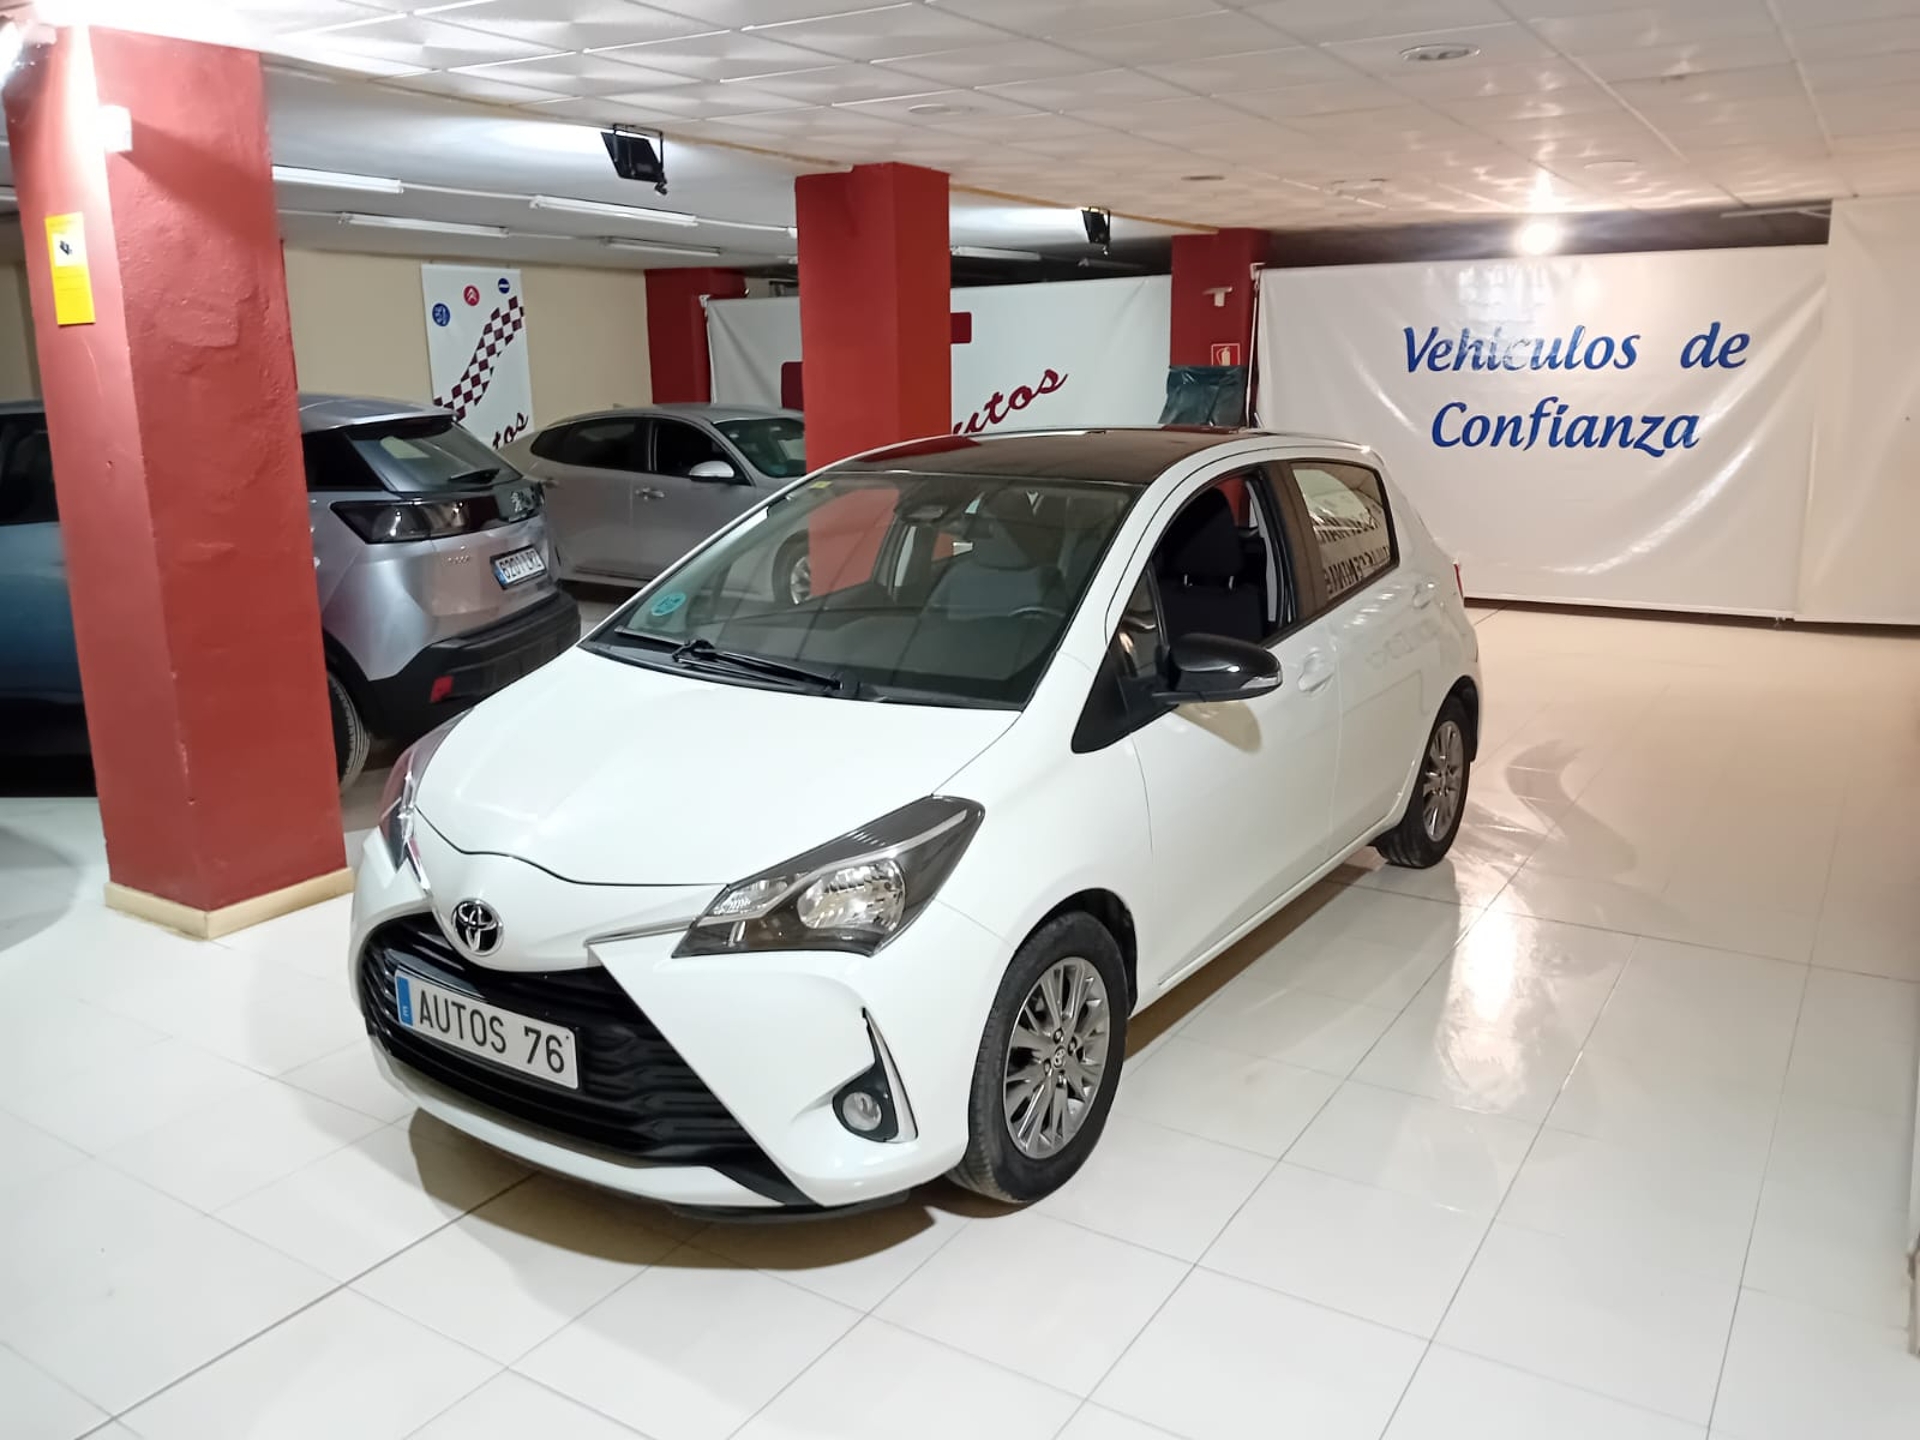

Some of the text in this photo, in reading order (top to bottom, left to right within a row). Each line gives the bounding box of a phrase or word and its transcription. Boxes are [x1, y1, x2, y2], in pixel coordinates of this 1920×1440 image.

[1680, 321, 1751, 369] de
[492, 412, 529, 450] tos
[953, 368, 1068, 434] utos
[1432, 396, 1700, 458] Confianza
[419, 989, 565, 1074] AUTOS 76
